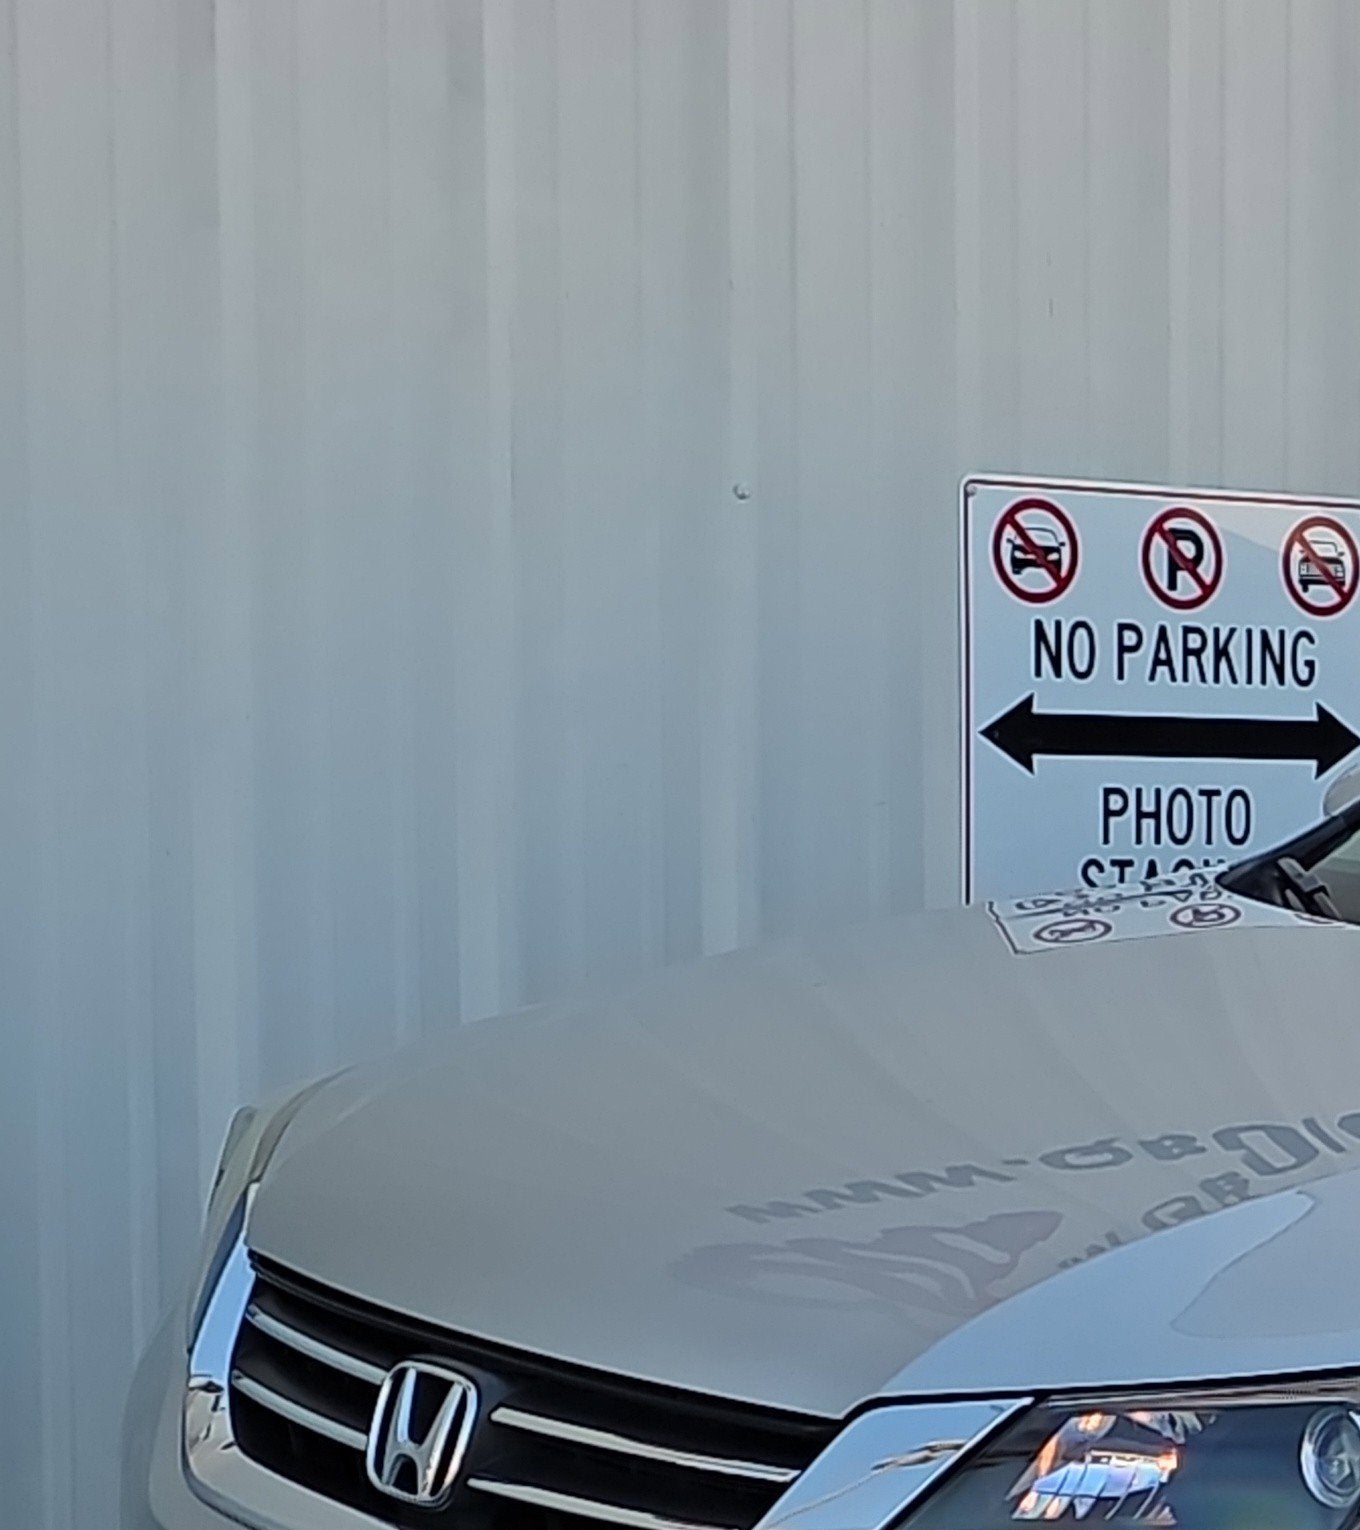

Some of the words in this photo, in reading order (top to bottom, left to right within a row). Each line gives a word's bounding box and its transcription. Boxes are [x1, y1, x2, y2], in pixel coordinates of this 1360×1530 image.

[1033, 618, 1097, 680] NO
[1116, 622, 1318, 688] PARKING
[1100, 786, 1253, 846] PHOTO
